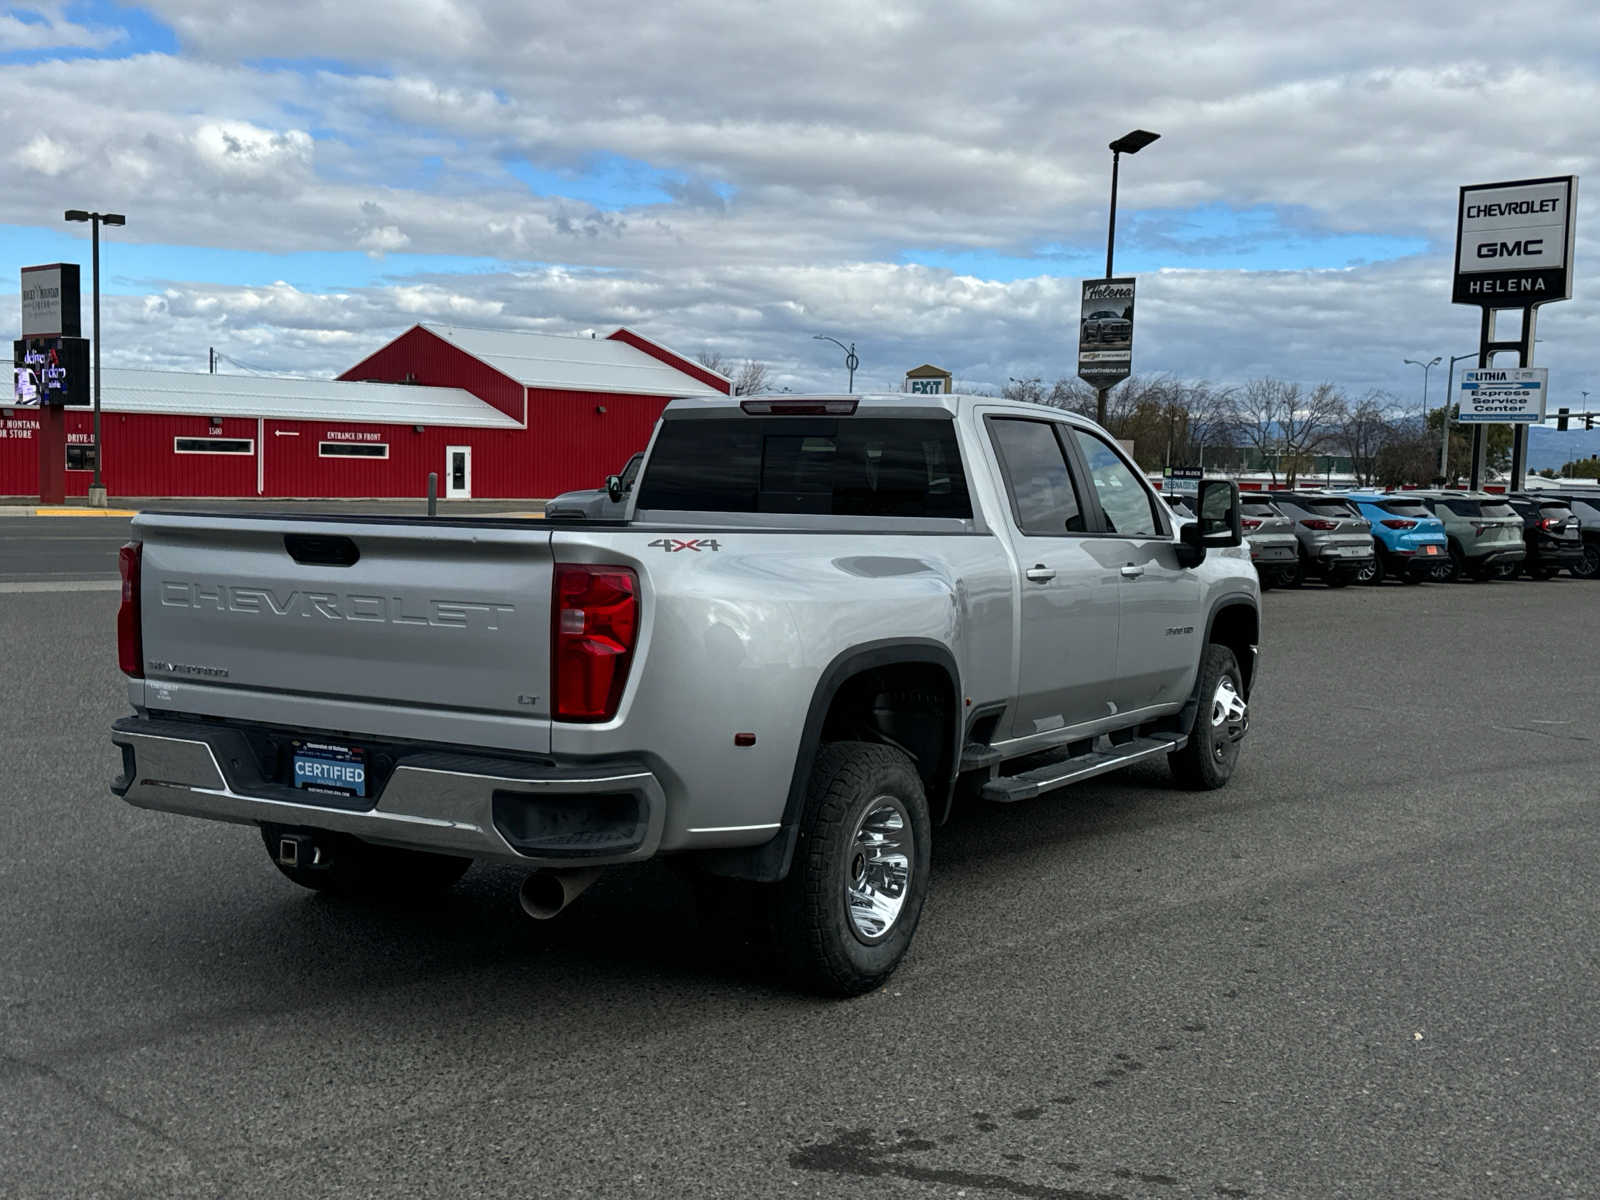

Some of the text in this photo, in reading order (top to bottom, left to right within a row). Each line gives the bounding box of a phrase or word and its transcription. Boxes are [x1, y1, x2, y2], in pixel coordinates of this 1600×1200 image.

[1467, 198, 1560, 218] CHEVROLET
[1477, 239, 1543, 258] GMC
[1087, 285, 1132, 298] Helena
[1469, 277, 1546, 294] HELENA
[1475, 372, 1507, 381] LITHIA
[912, 380, 941, 395] EXIT
[6, 420, 40, 430] MONTANA
[9, 430, 33, 439] STORE
[327, 431, 355, 440] ENTRANCE
[364, 433, 381, 441] FRONT
[161, 580, 516, 631] CHEVROLET
[295, 761, 365, 783] CERTIFIED
